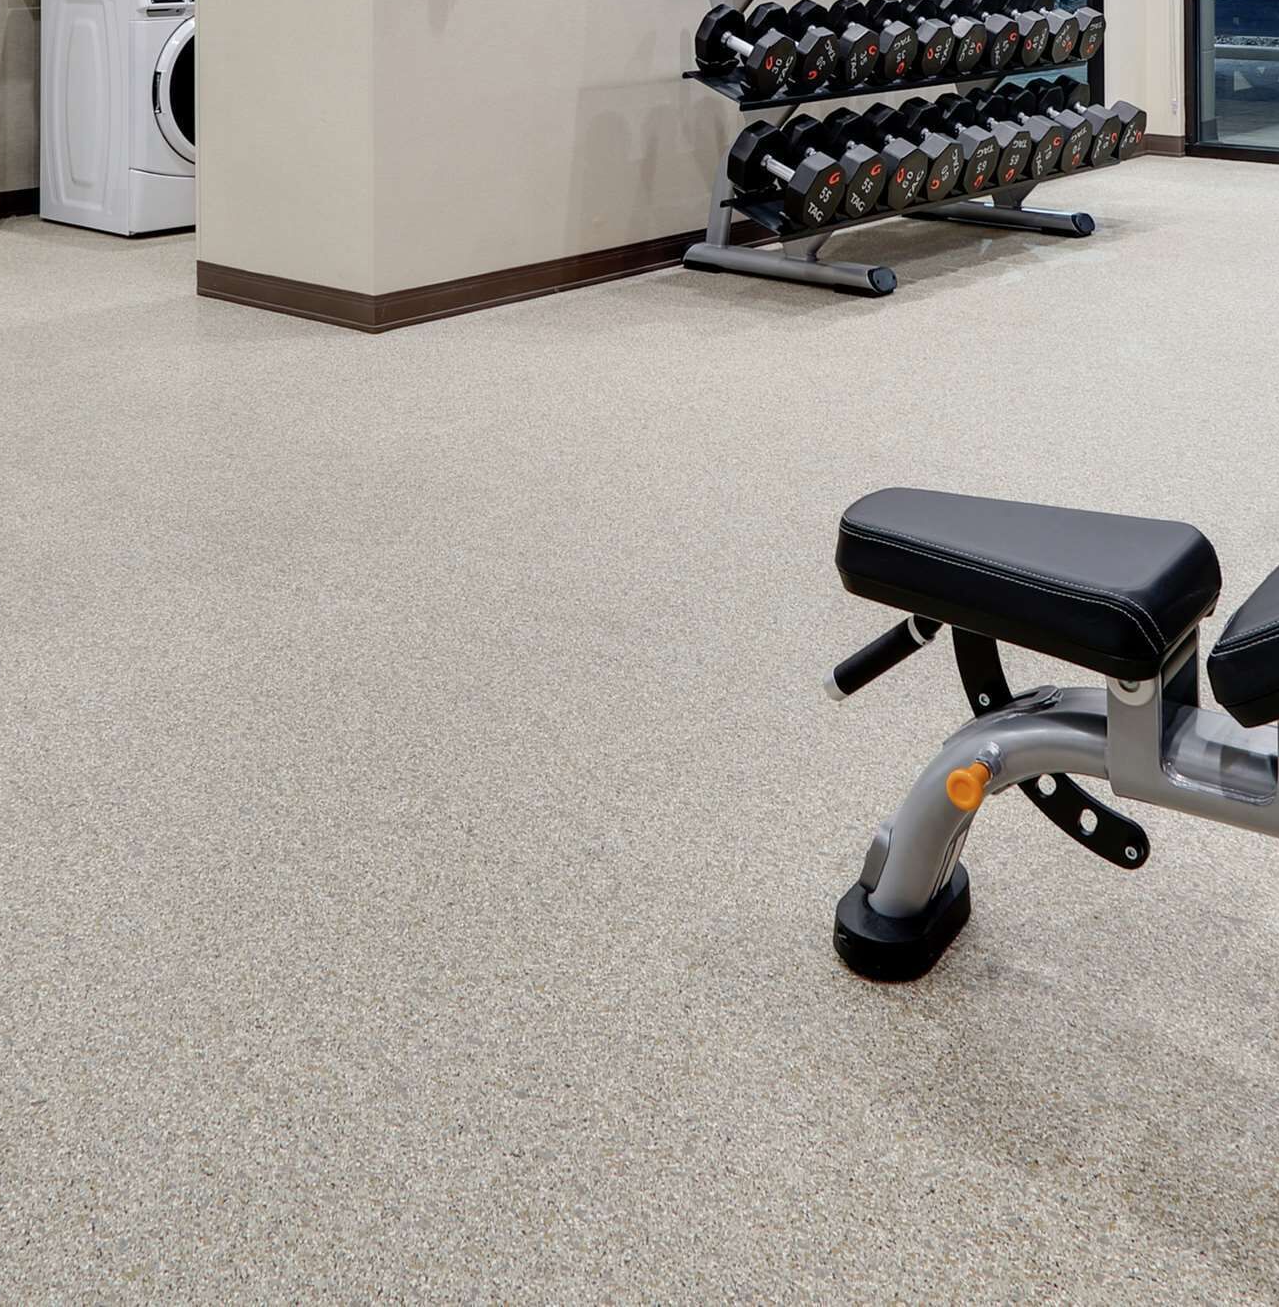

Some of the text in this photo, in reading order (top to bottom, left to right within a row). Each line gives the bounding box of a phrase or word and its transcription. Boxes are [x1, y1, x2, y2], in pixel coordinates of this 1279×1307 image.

[824, 39, 836, 62] TAG
[893, 35, 911, 50] TAG
[772, 58, 782, 74] 30
[776, 56, 794, 84] TAG
[1072, 126, 1088, 142] TAG
[976, 144, 994, 158] TAG
[1012, 140, 1028, 148] TAG
[861, 178, 874, 194] 55
[902, 171, 914, 188] 60
[905, 170, 924, 199] TAG
[819, 186, 832, 203] 55
[850, 192, 866, 213] TAG
[807, 202, 824, 222] TAG
